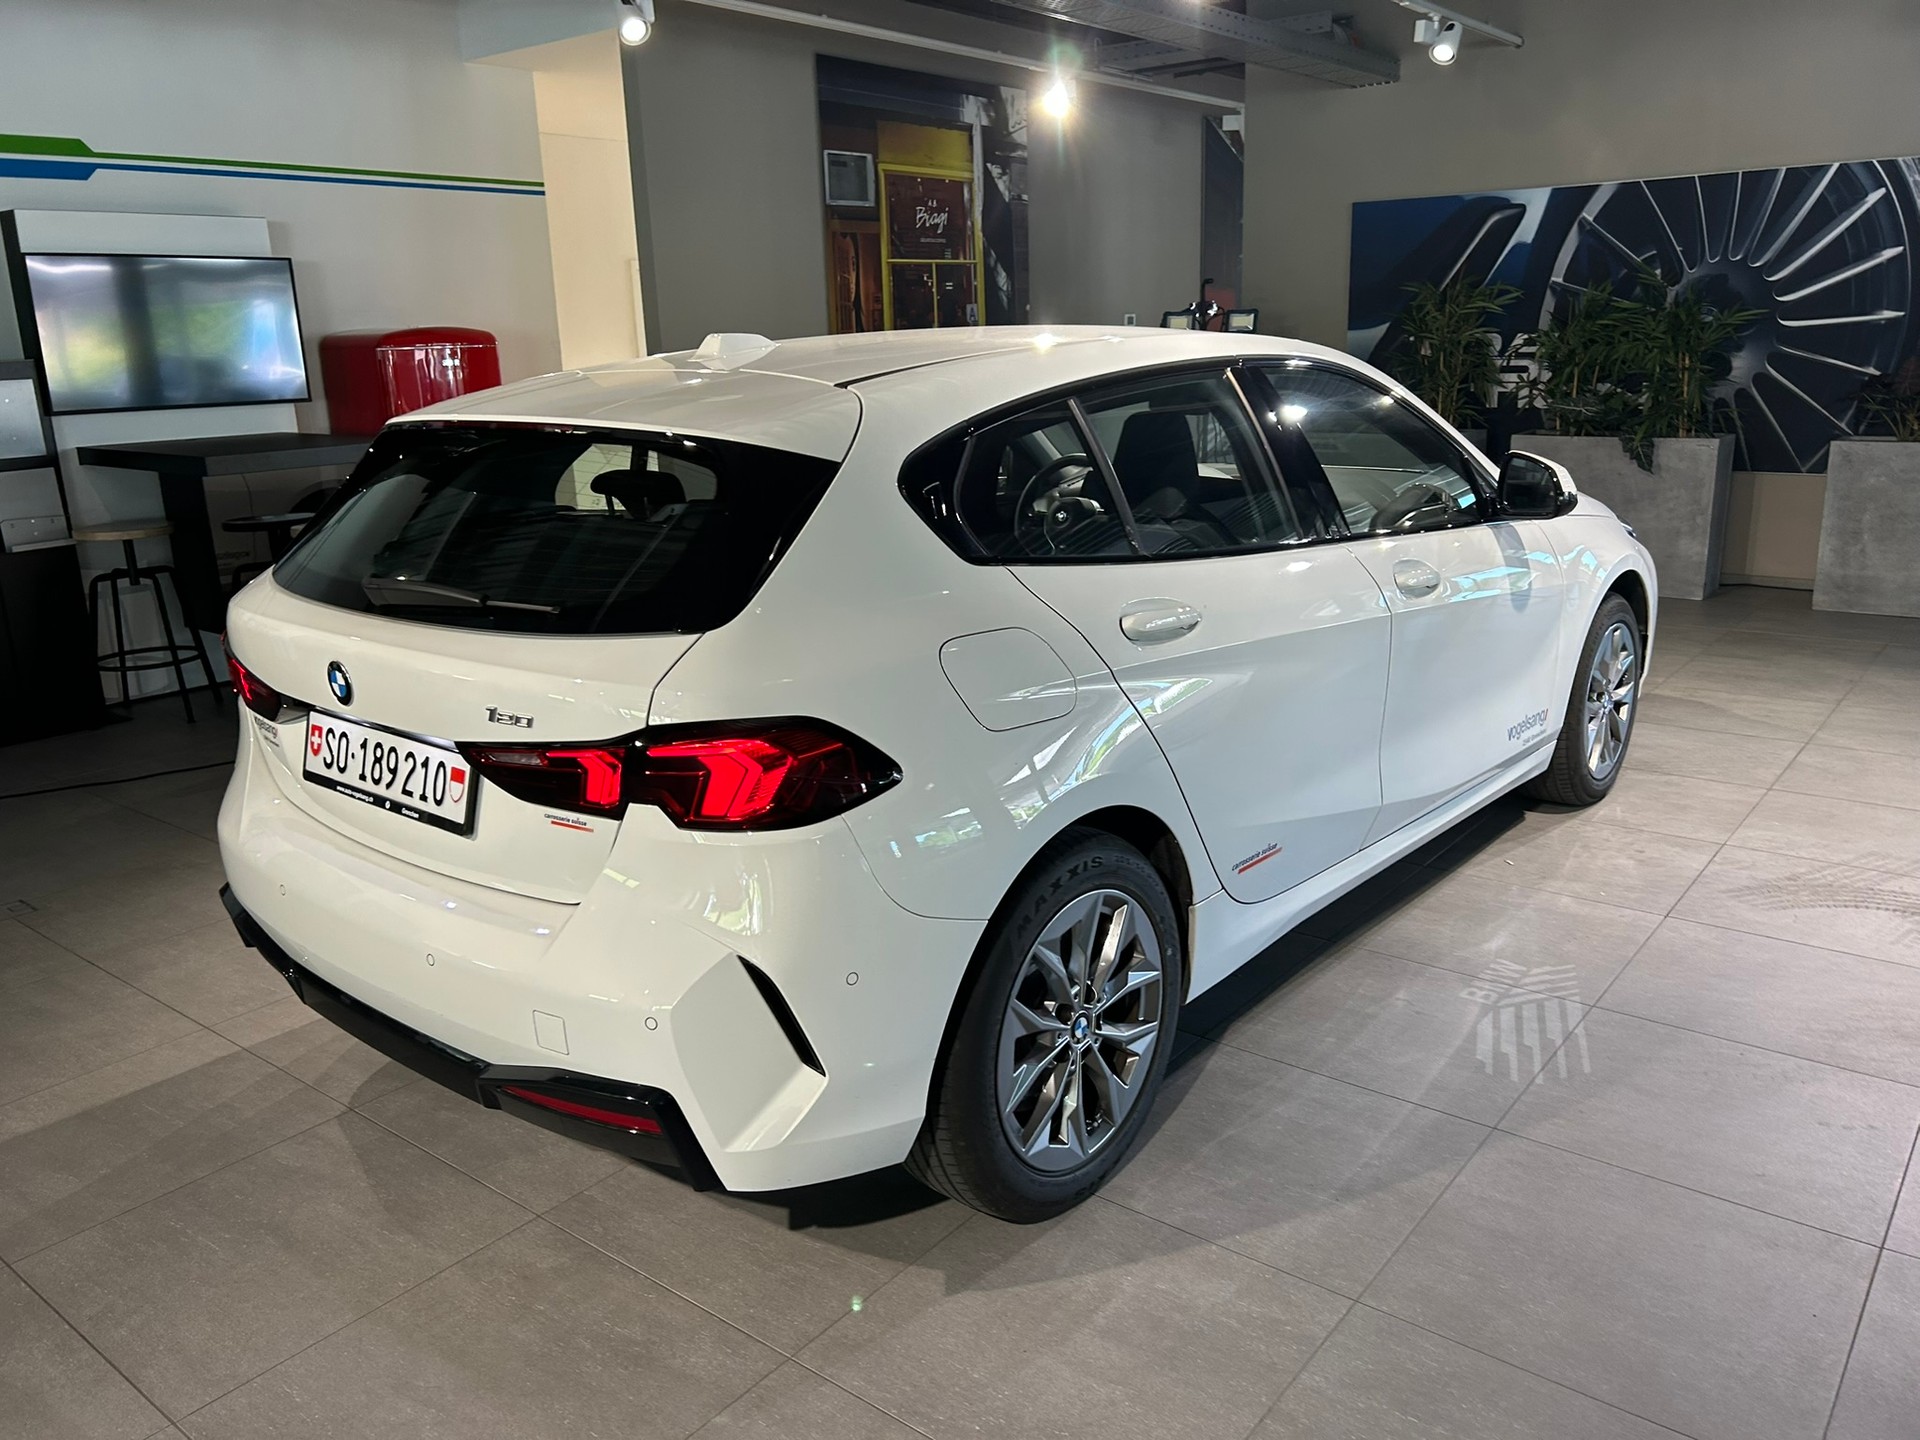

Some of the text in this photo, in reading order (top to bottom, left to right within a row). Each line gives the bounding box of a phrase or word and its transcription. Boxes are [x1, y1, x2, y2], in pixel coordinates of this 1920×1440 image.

[915, 206, 949, 234] Biagi
[485, 705, 534, 728] 120
[1016, 856, 1104, 940] MAXXIS
